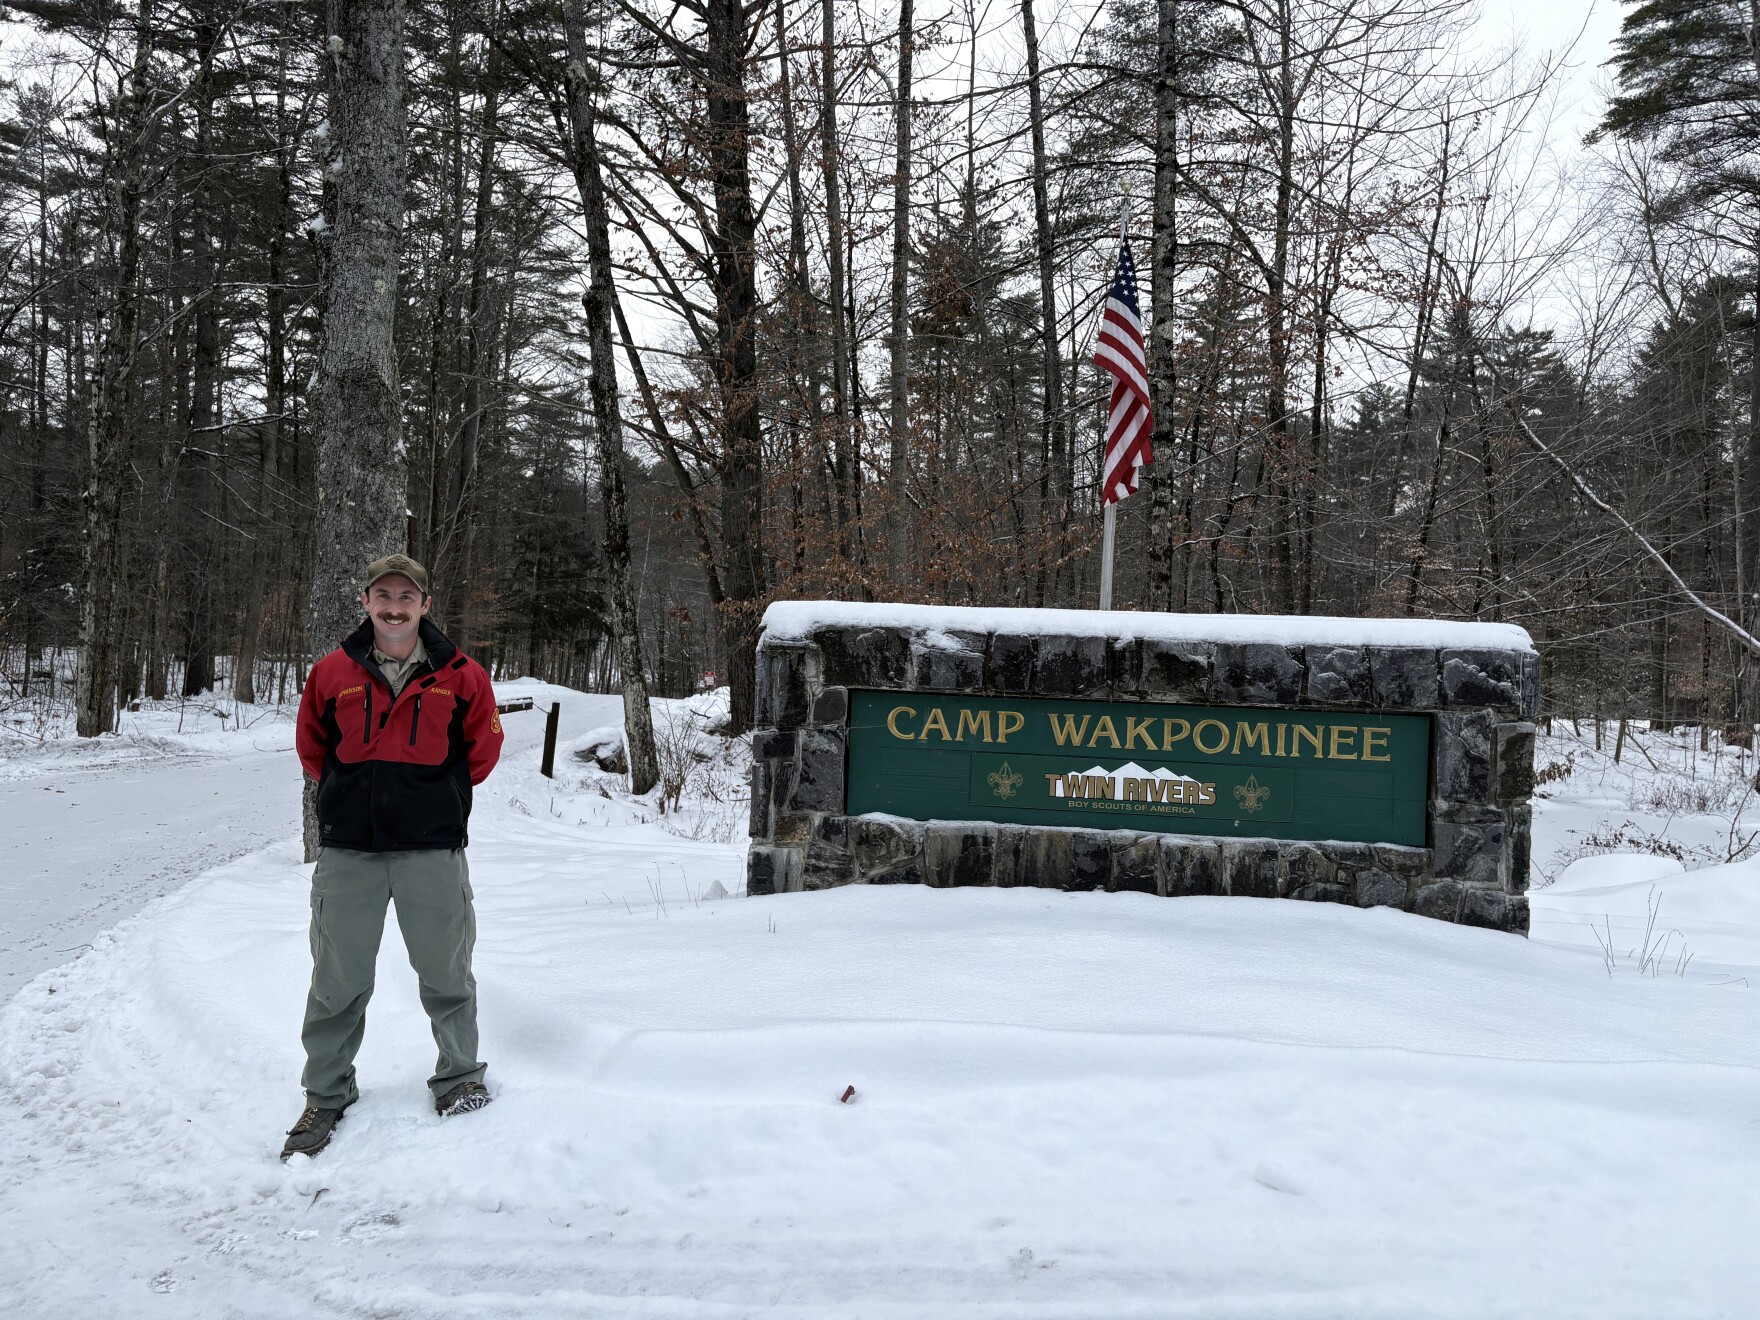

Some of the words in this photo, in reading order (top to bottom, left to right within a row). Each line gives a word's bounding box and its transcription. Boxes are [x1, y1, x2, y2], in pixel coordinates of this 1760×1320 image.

[431, 687, 451, 696] RANGER
[887, 706, 1025, 743] CAMP
[1047, 713, 1391, 762] WAKPOMINEE
[1044, 773, 1116, 801] TWIN
[1123, 777, 1217, 806] RIVERS
[1068, 800, 1089, 808] BOY
[1092, 801, 1132, 811] SCOUTS
[1150, 805, 1196, 814] AMERICA
